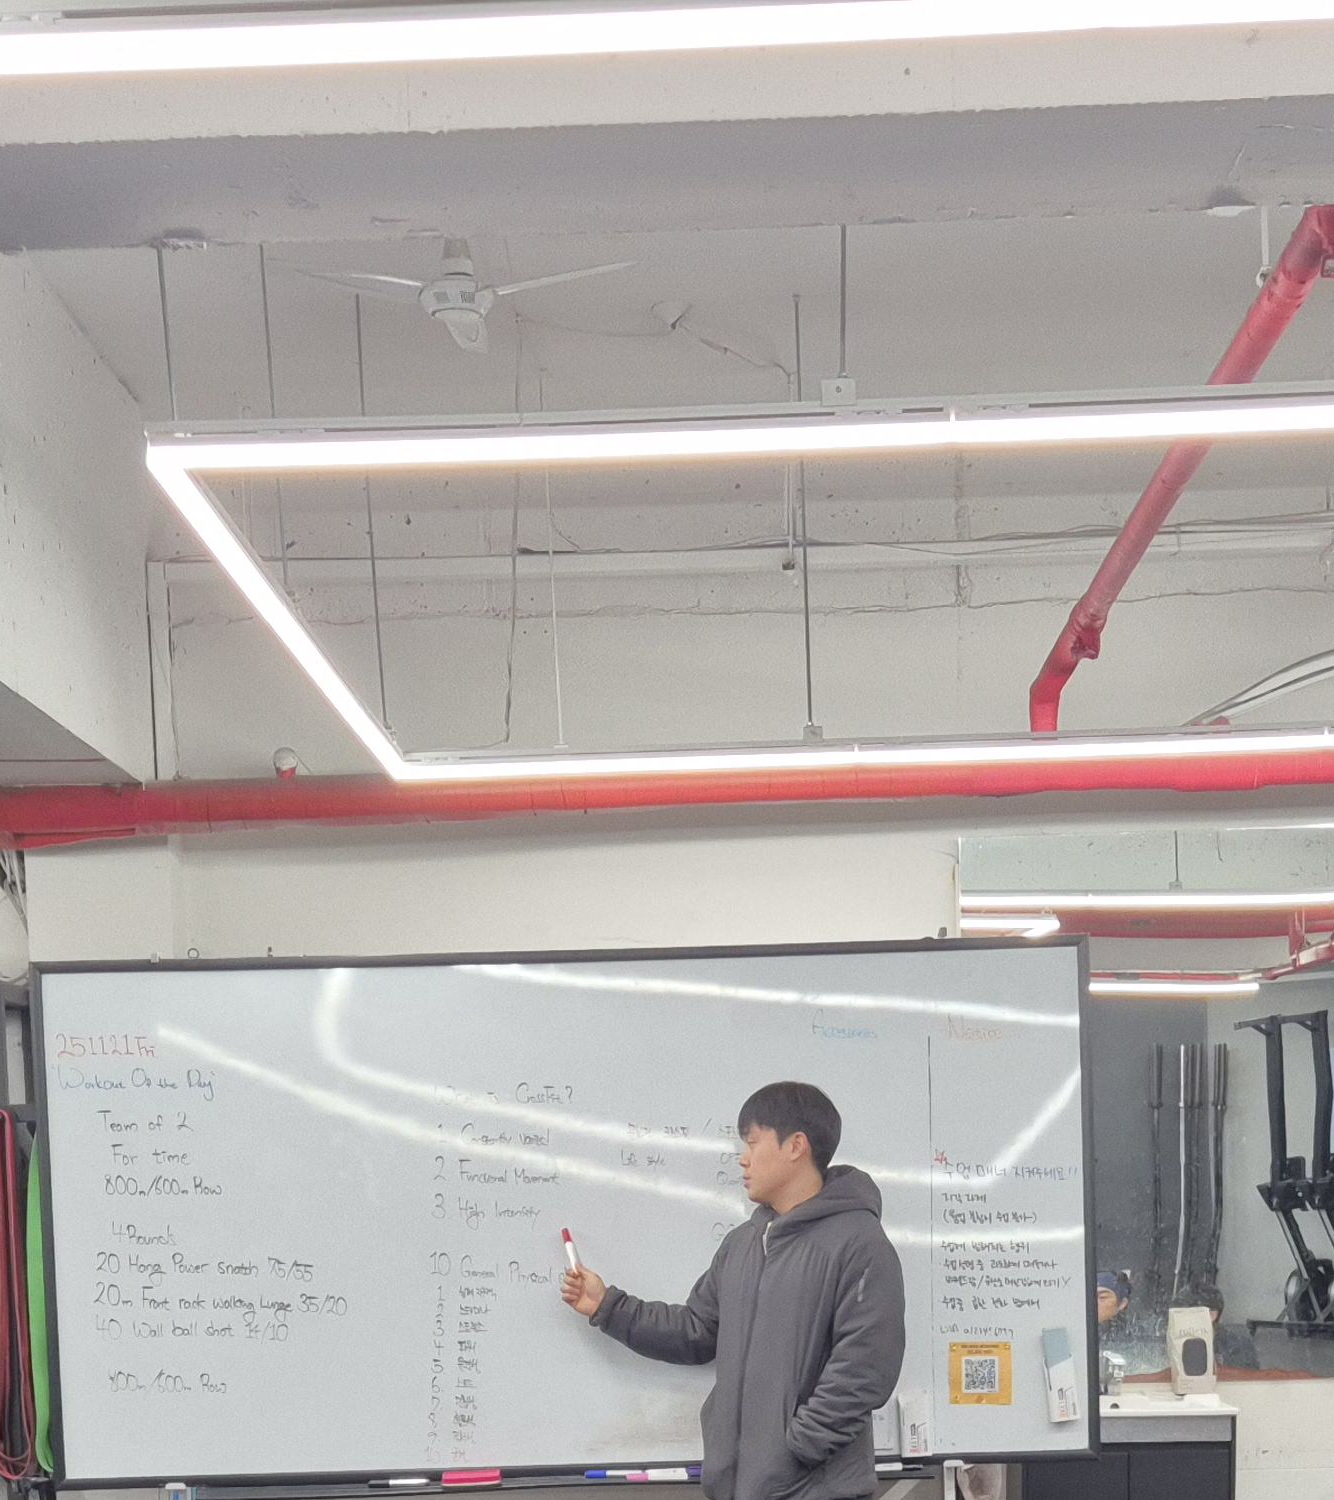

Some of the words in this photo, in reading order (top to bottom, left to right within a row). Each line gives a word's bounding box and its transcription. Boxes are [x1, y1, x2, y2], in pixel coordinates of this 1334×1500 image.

[97, 1109, 138, 1132] Team
[148, 1115, 163, 1131] of
[177, 1111, 194, 1132] 2
[111, 1143, 138, 1166] For
[151, 1149, 190, 1167] time
[193, 1176, 222, 1196] Row
[96, 1251, 120, 1274] 20
[128, 1254, 167, 1286] Hang
[171, 1252, 209, 1275] Power
[94, 1281, 133, 1307] 20m
[296, 1293, 347, 1316] 35/20
[96, 1314, 122, 1340] 40
[133, 1320, 163, 1338] Wall
[172, 1320, 198, 1337] ball
